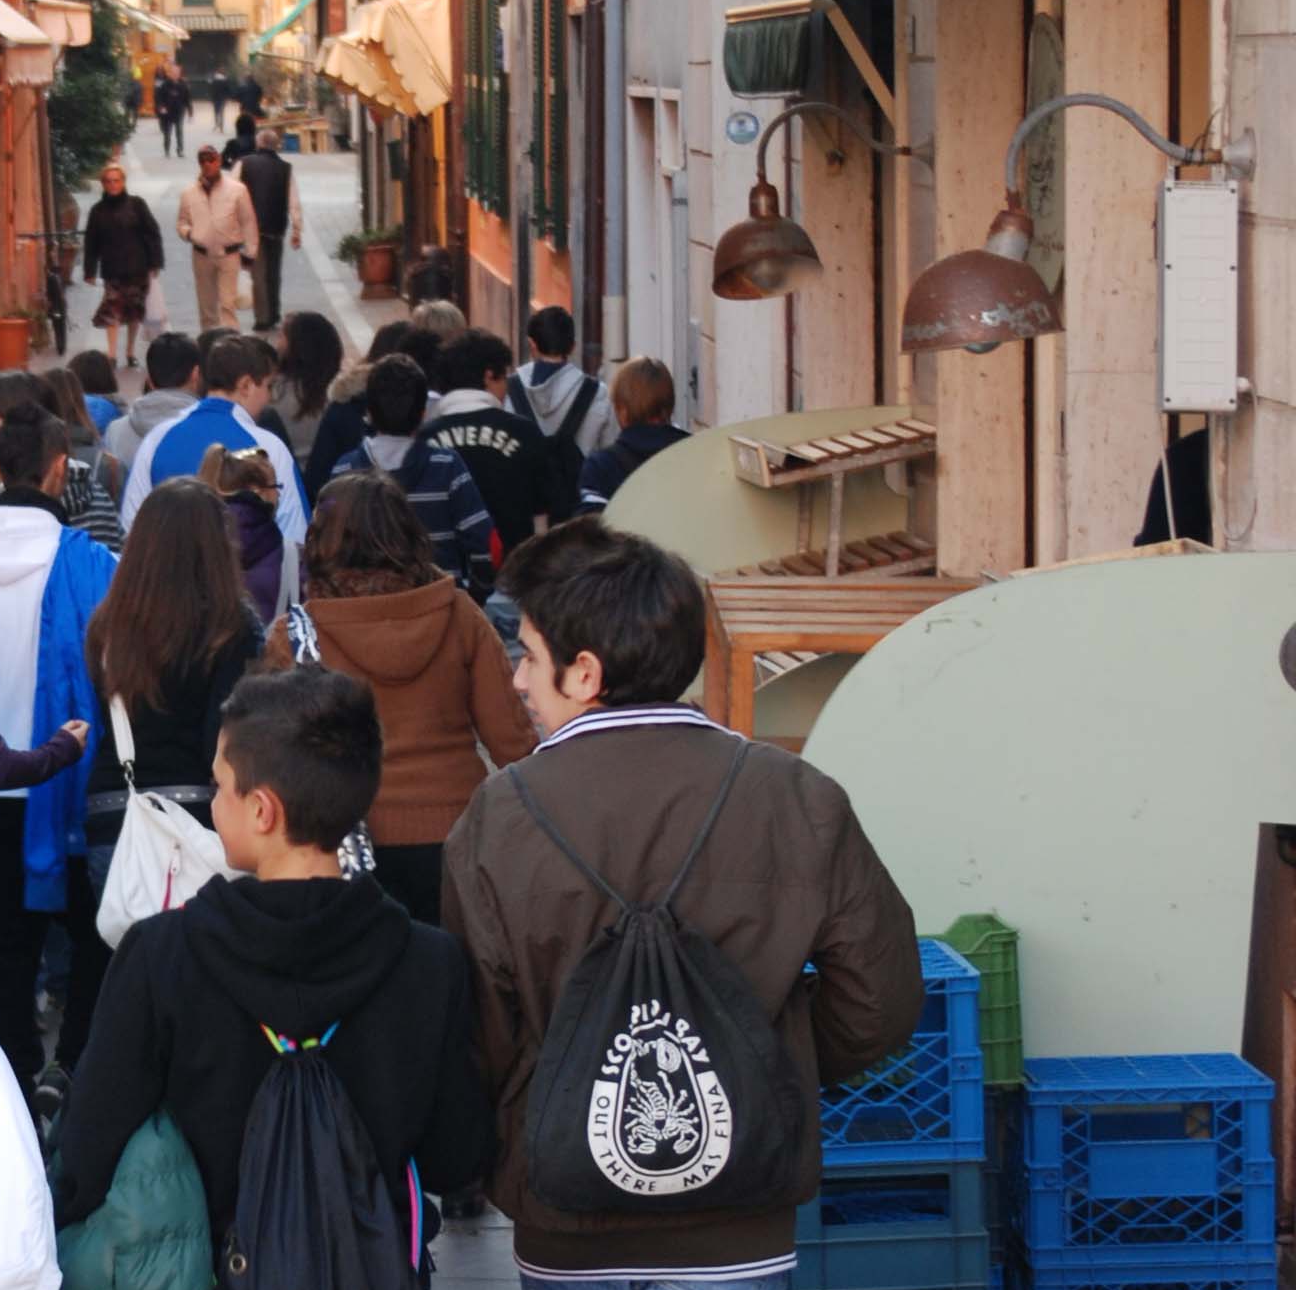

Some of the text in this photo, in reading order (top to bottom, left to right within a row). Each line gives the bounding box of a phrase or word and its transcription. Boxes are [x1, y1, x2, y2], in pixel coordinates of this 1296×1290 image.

[675, 1017, 711, 1064] BAY
[593, 1084, 729, 1192] OUT THERE MAS FINA
